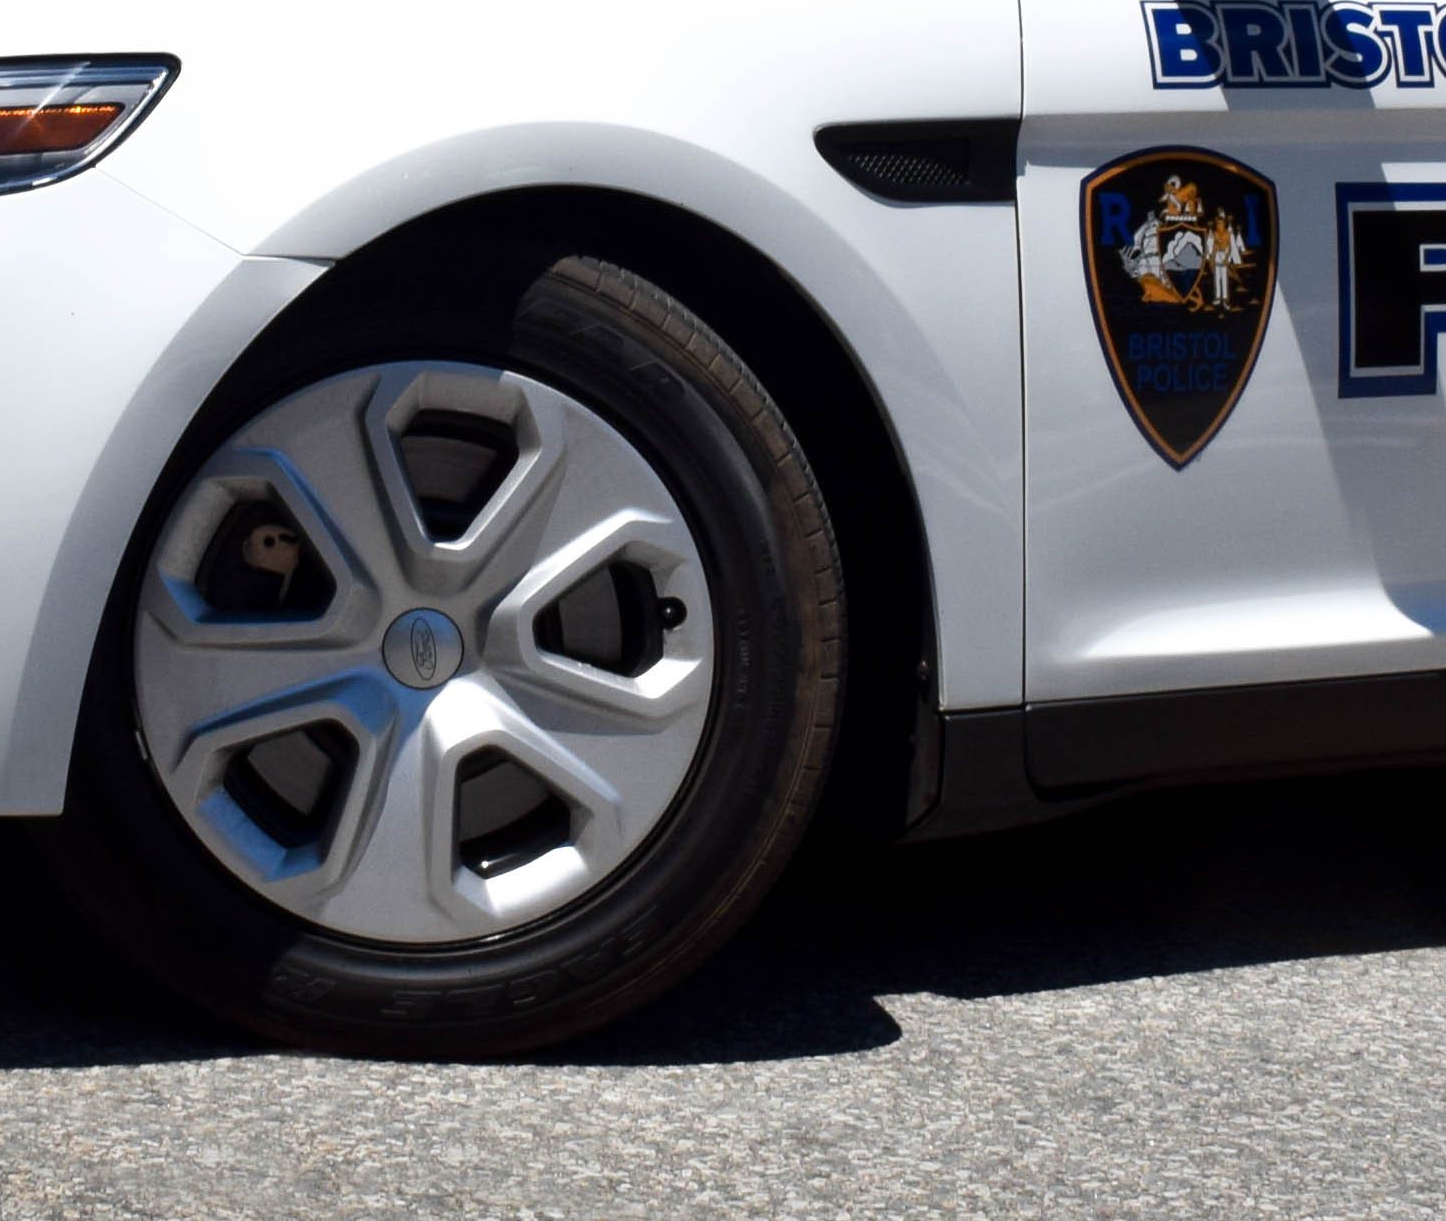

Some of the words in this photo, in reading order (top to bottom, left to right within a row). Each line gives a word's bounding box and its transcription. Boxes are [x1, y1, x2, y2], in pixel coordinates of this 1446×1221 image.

[1098, 191, 1136, 247] R
[1129, 332, 1238, 361] BRISTOL
[1136, 363, 1227, 391] POLICE
